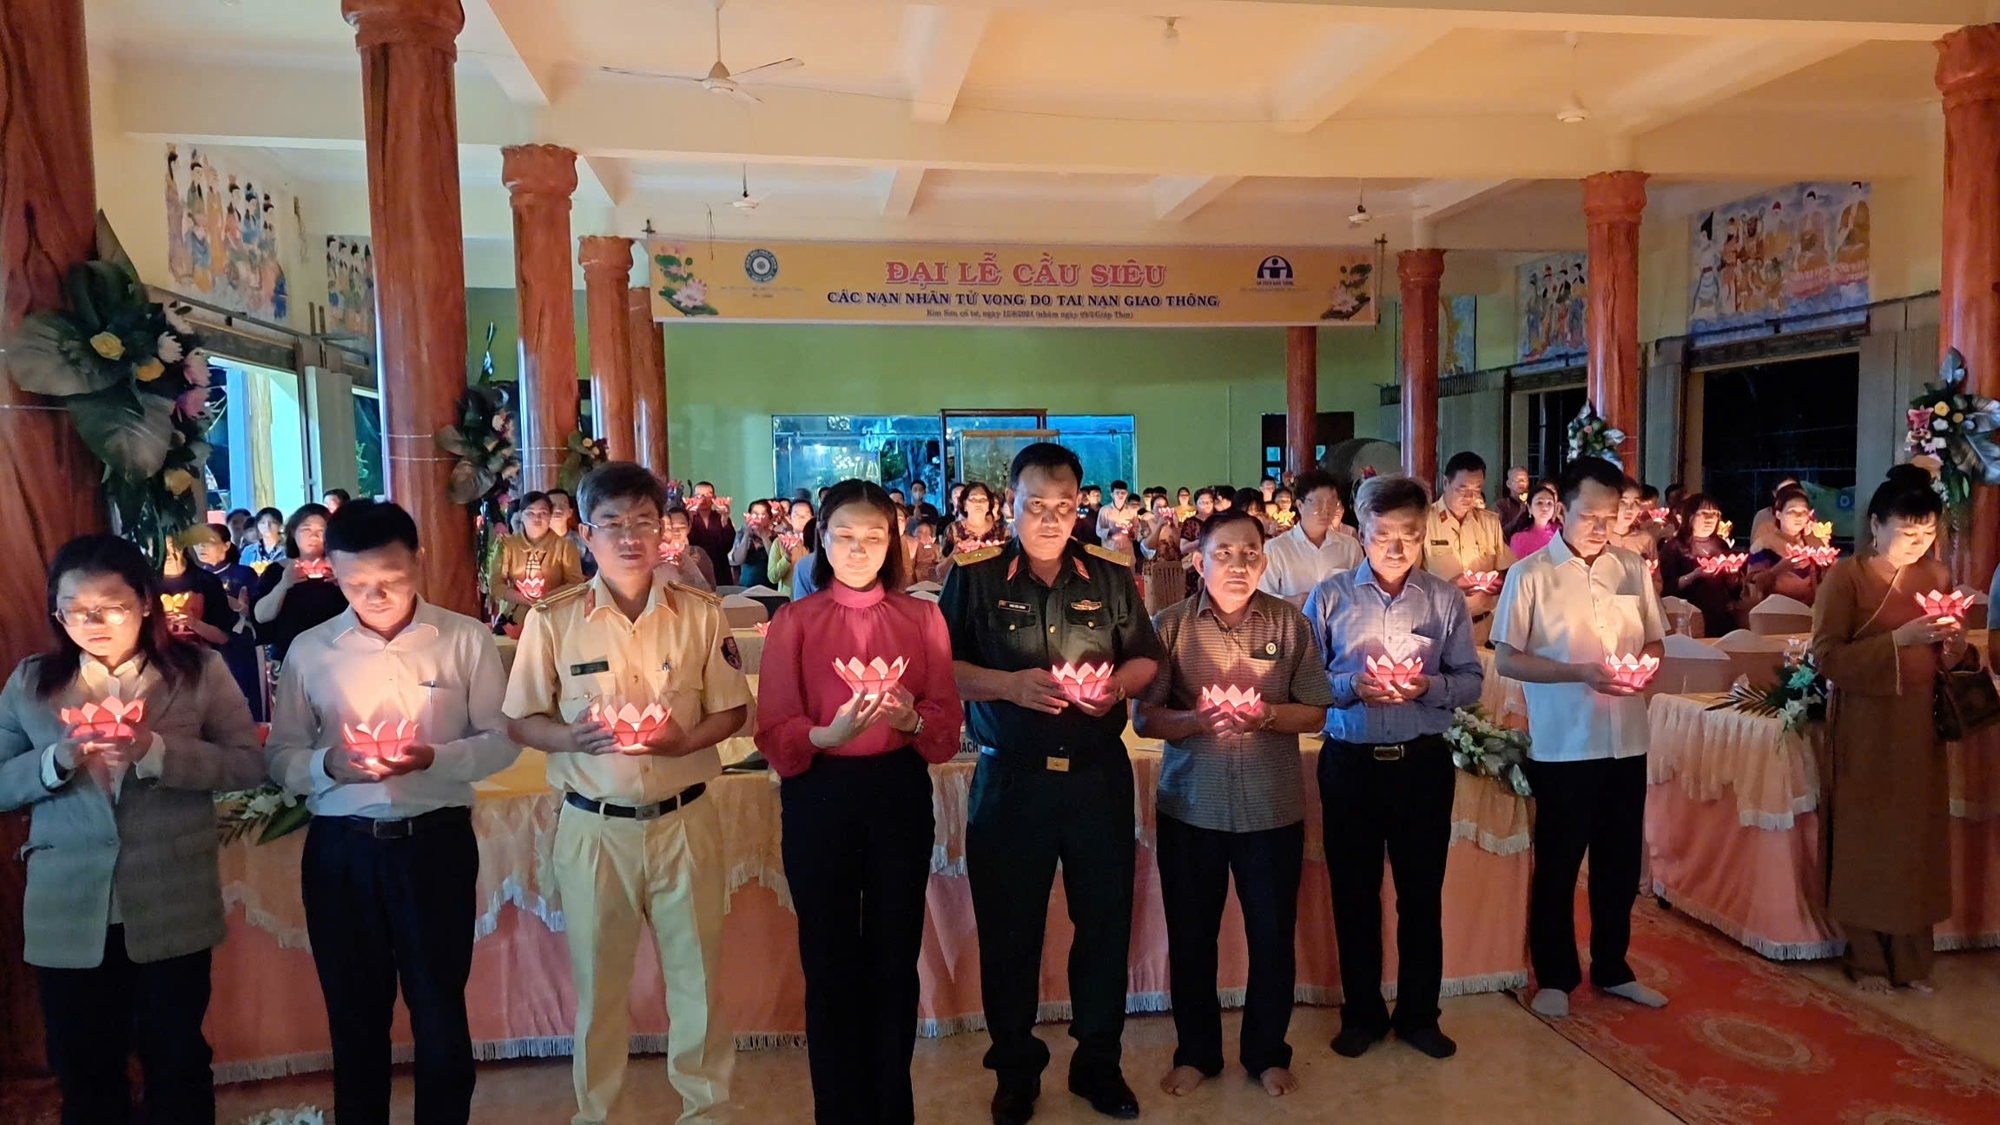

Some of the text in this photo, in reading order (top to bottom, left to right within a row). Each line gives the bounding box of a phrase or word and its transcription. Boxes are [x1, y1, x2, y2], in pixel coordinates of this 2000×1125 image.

[885, 252, 1167, 289] ĐẠI LỄ CẦU SIÊU
[827, 289, 1219, 309] CÁC NẠN NHÂN TỬ VONG DO TAI NẠN GIAO THÔNG
[927, 309, 941, 317] Kim
[1060, 310, 1079, 320] ngày
